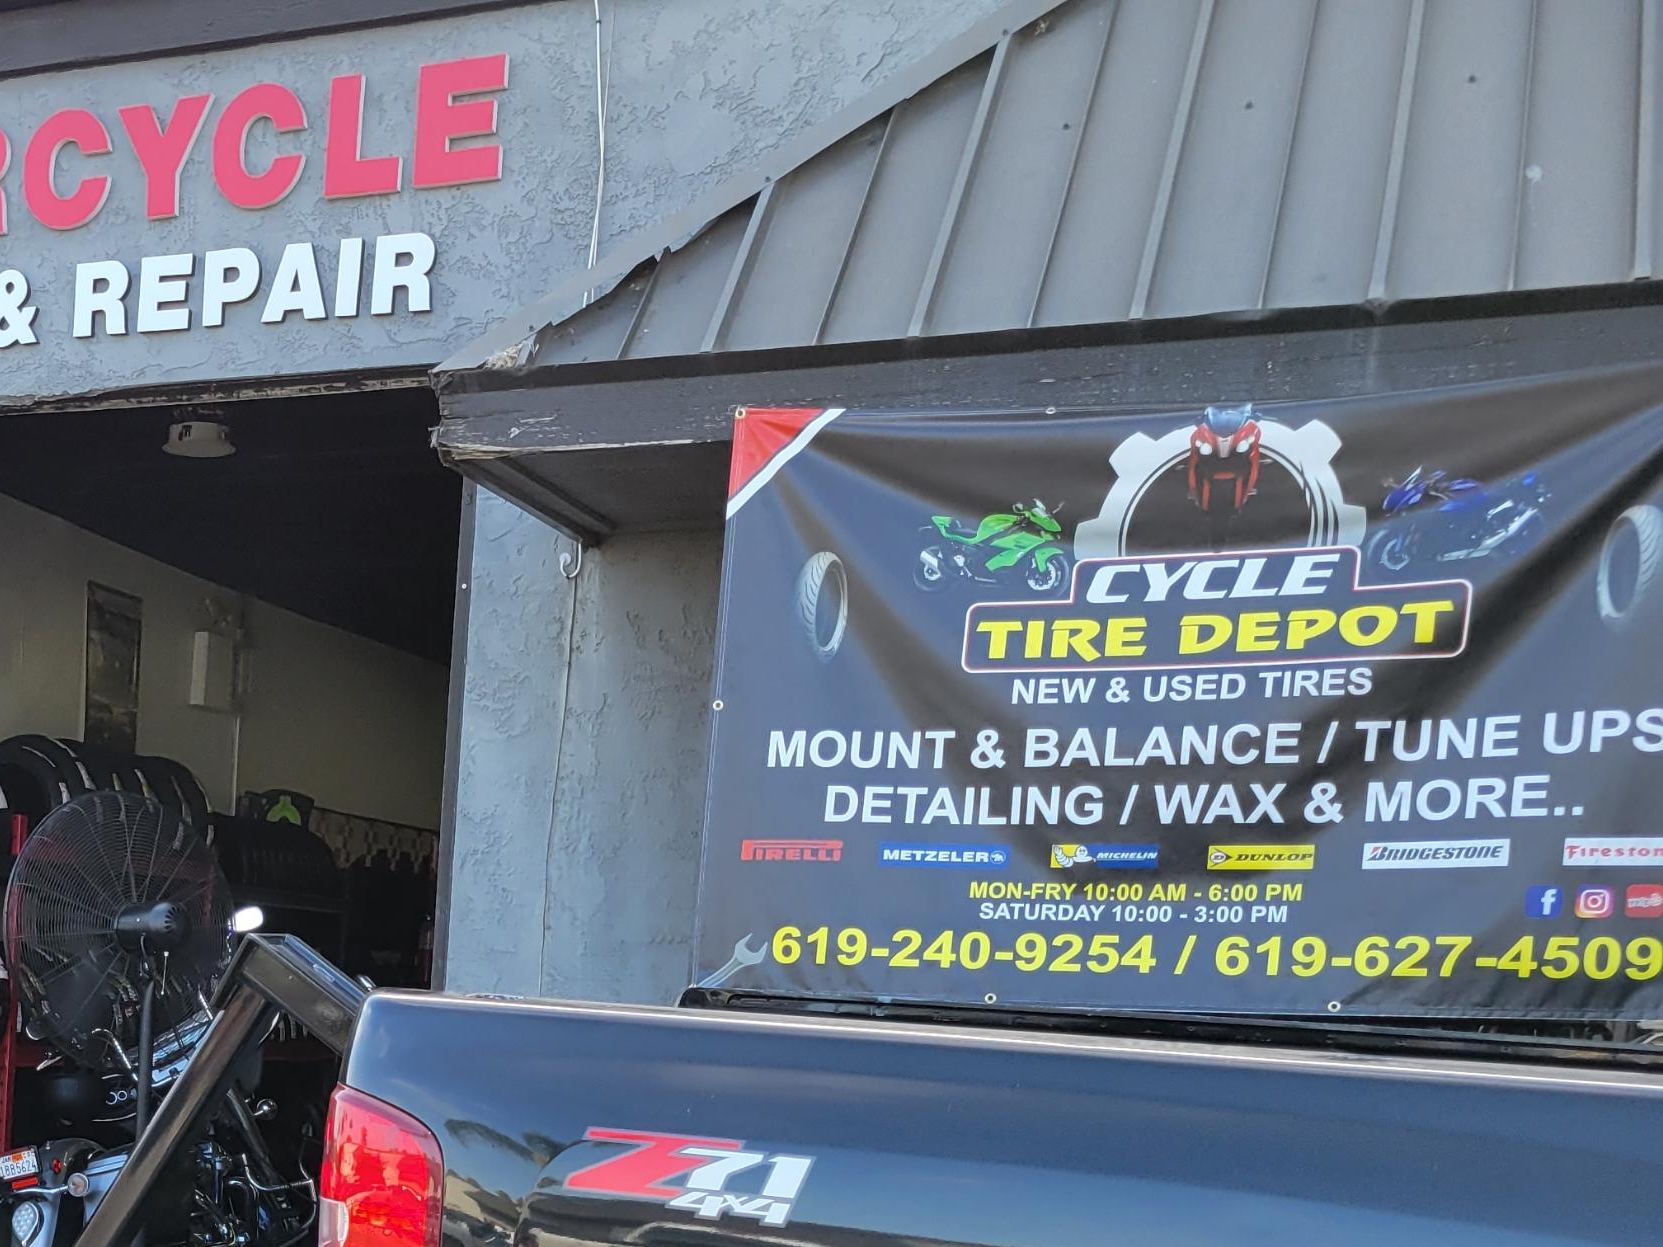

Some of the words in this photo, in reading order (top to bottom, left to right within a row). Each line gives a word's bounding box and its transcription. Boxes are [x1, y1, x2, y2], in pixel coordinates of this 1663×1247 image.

[73, 232, 436, 337] REPAIR
[1084, 553, 1340, 603] CYCLE
[977, 617, 1146, 661] TIRE
[1179, 600, 1454, 654] DEPOT
[1011, 678, 1095, 705] NEW
[1105, 677, 1130, 703] &
[1143, 672, 1246, 701] USED
[1259, 668, 1373, 697] TIRES
[767, 730, 956, 769] MOUNT
[970, 730, 1006, 768] &
[1025, 723, 1301, 767] BALANCE
[1318, 721, 1339, 763] /
[1356, 715, 1520, 761] TUNE
[1543, 708, 1663, 754] UPS
[825, 785, 1103, 825] DETAILING
[1120, 784, 1139, 825] /
[1155, 783, 1287, 825] WAX
[1304, 782, 1344, 823] &
[1365, 775, 1583, 822] MORE..
[741, 839, 843, 861] PIRELLI
[883, 850, 989, 863] METZELER
[1096, 850, 1158, 861] MICHELIN
[1235, 853, 1313, 861] DUNLOP
[1367, 844, 1501, 861] BRIDGESTONE
[969, 881, 1075, 899] MON-FRY
[1083, 883, 1142, 901] 10:00
[1148, 884, 1186, 901] AM
[1208, 884, 1258, 901] 6:00
[1265, 884, 1302, 901] PM
[979, 903, 1105, 921] SATURDAY
[1111, 905, 1172, 922] 10:00
[1194, 905, 1243, 922] 3:00
[1251, 905, 1288, 923] PM
[772, 926, 1156, 974] 619-240-9254
[1175, 935, 1196, 974] /
[1215, 935, 1663, 981] 619-627-4509
[563, 1127, 816, 1199] Z71
